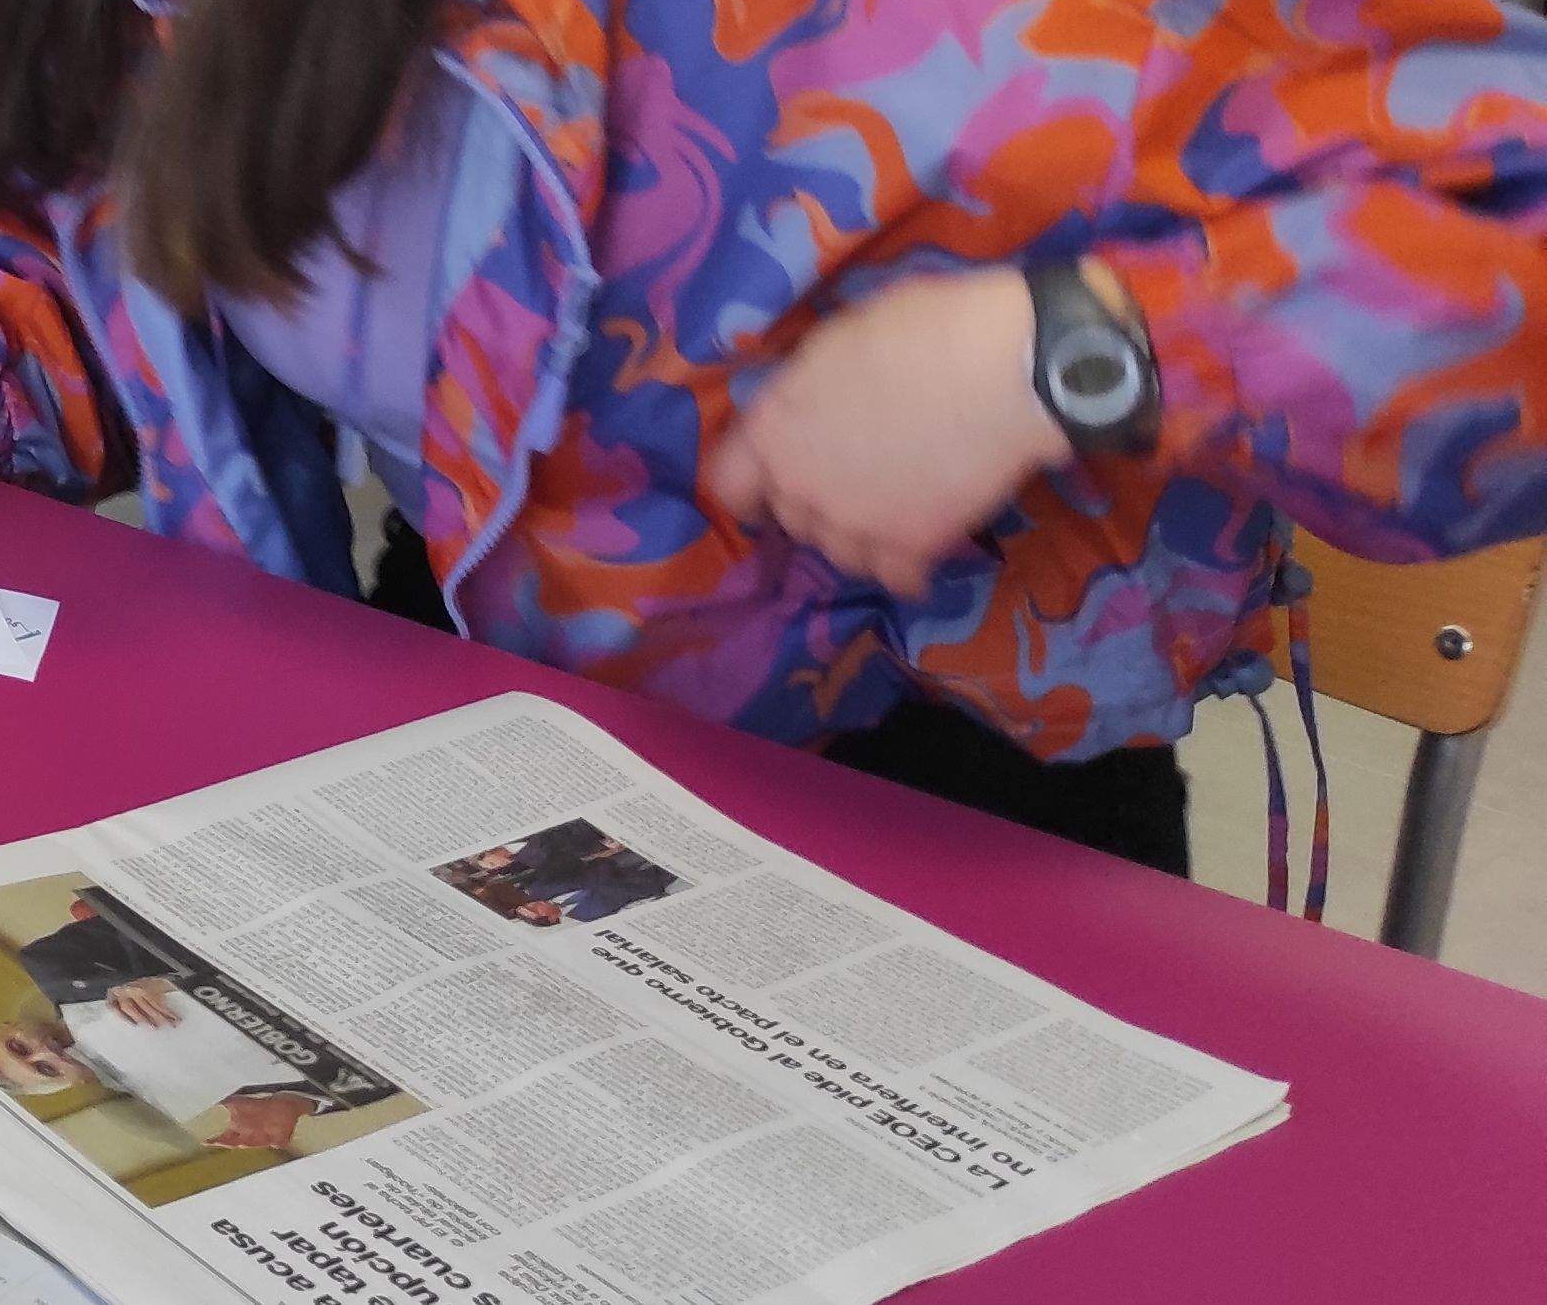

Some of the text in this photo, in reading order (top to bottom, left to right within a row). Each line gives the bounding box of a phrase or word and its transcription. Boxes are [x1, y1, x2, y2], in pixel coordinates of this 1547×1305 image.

[593, 929, 694, 984] salarial
[193, 985, 317, 1065] GOBIERNO
[696, 985, 780, 1030] pacto
[770, 1031, 804, 1047] el
[591, 946, 1009, 1190] La CEOE pide al Gobierno que
[808, 1048, 847, 1070] en
[850, 1071, 989, 1152] interfiera
[991, 1151, 1035, 1176] no
[211, 1218, 316, 1292] acusa
[271, 1229, 367, 1294] tapar
[310, 1181, 472, 1289] cuarteles
